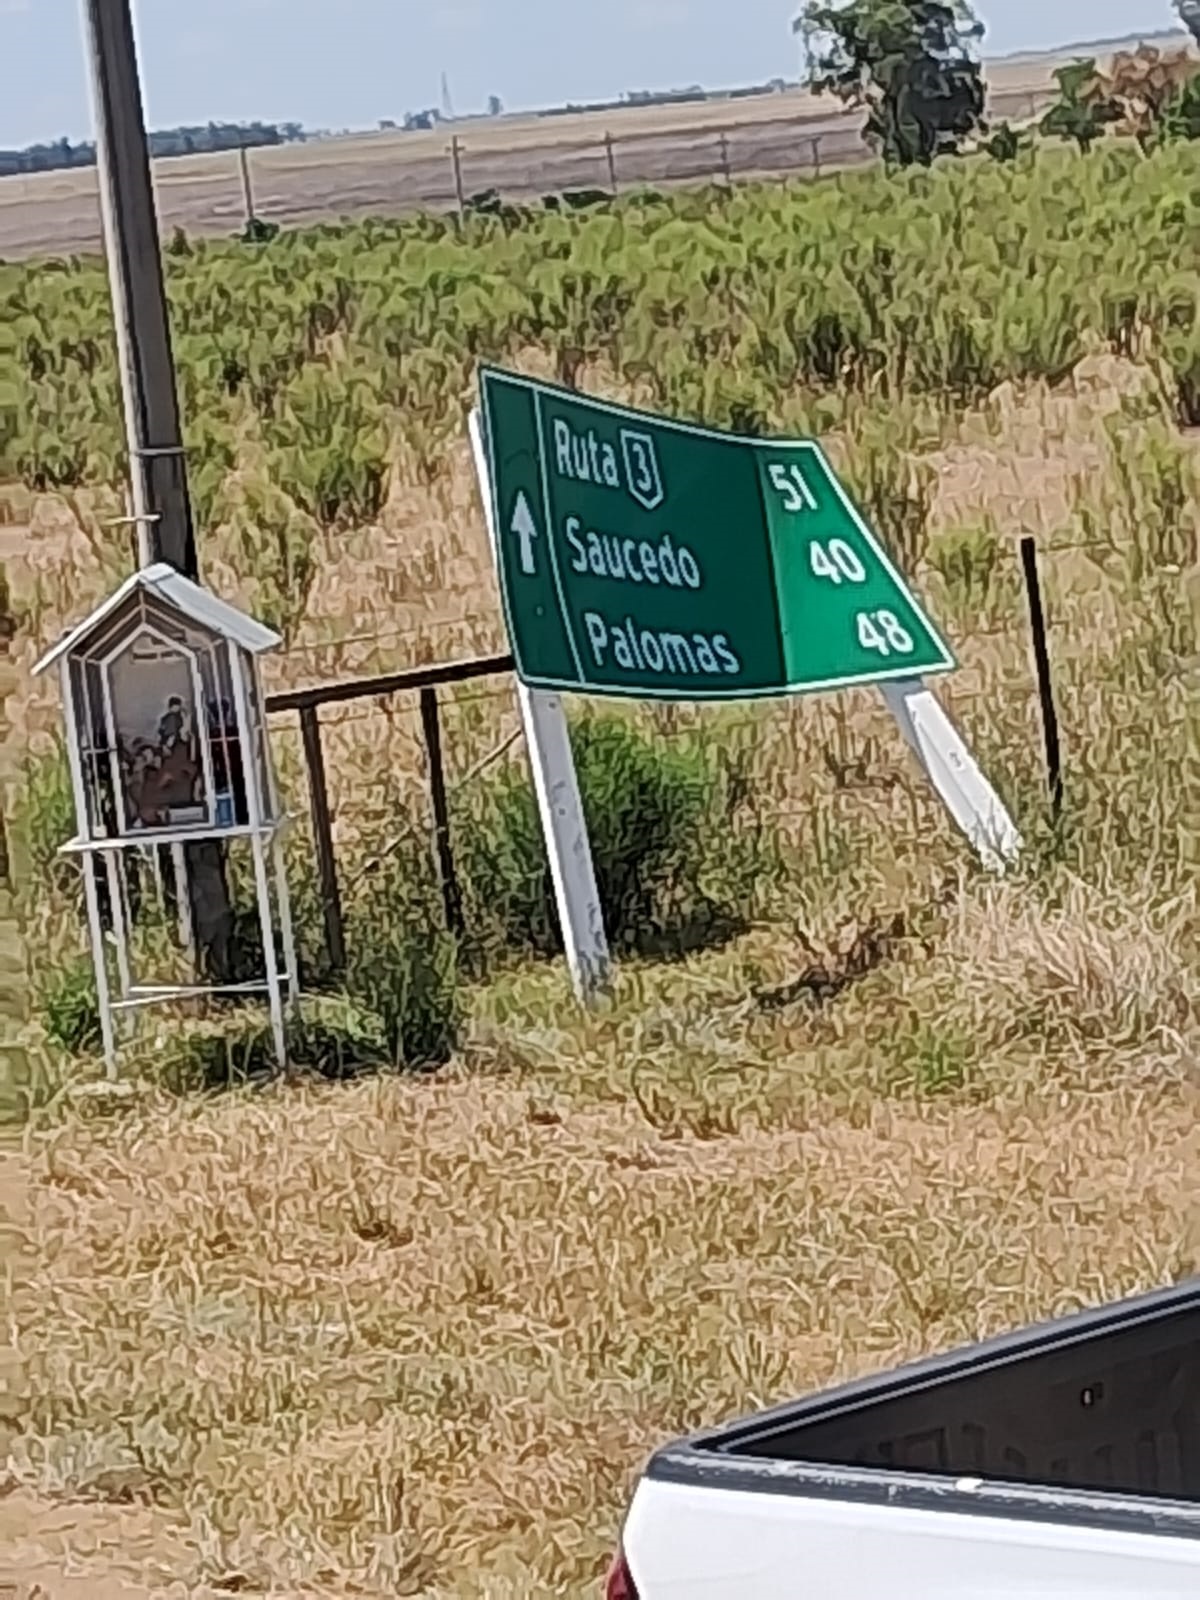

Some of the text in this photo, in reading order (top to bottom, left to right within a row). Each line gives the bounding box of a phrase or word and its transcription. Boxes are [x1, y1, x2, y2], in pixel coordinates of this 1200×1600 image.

[554, 420, 818, 511] Ruta 3 51
[565, 517, 866, 588] Saucedo 40
[584, 609, 914, 674] Palomas 48
